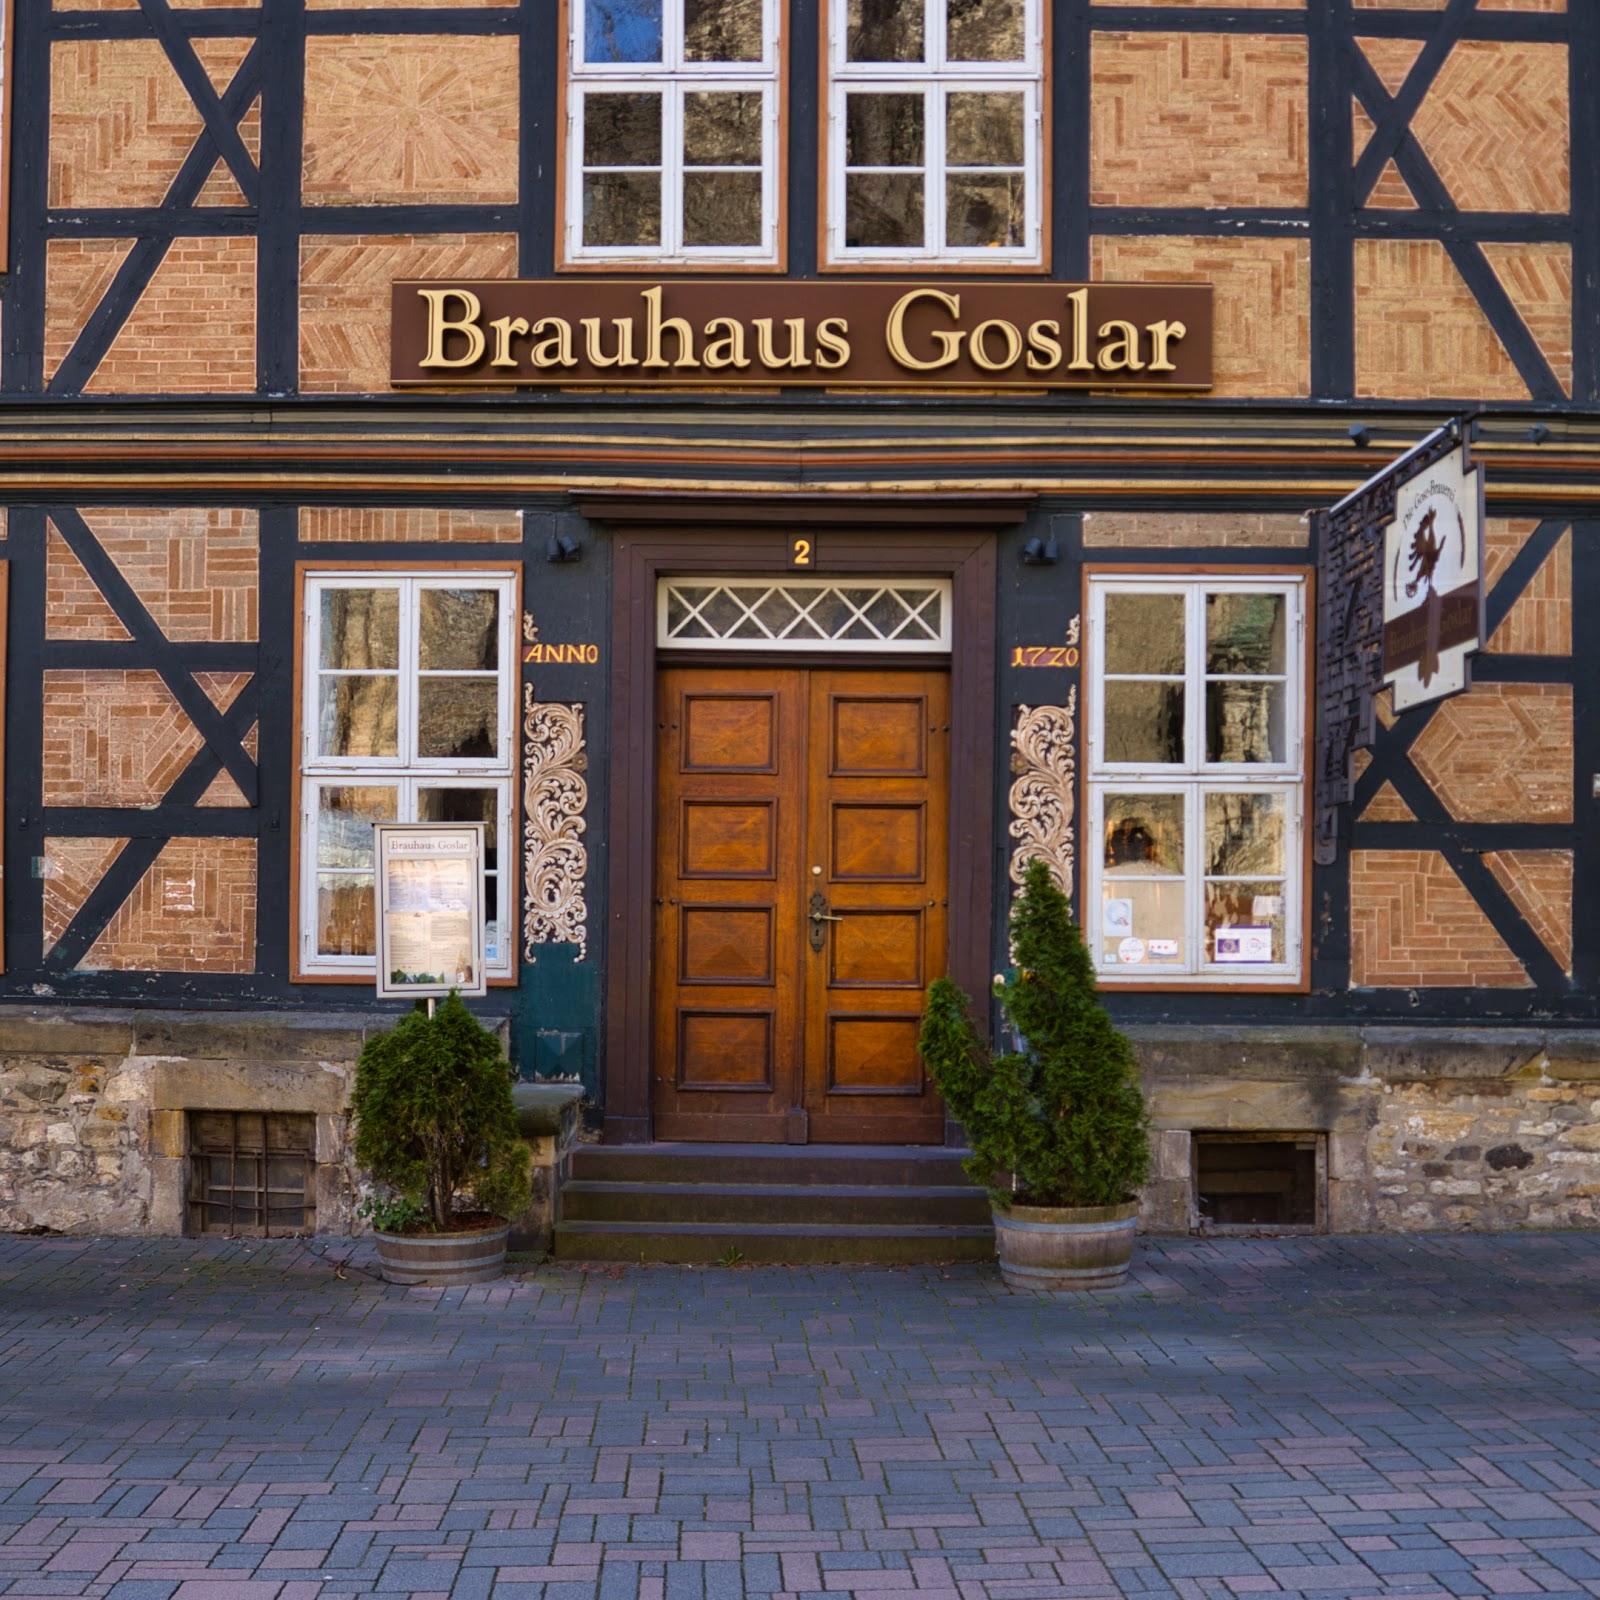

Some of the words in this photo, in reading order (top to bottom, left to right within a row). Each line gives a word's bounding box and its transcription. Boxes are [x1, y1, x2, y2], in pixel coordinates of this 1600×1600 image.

[417, 285, 851, 369] Brauhaus
[885, 287, 1187, 371] Goslar
[794, 539, 810, 565] 2
[524, 643, 599, 664] ANNO
[1010, 646, 1079, 668] 1720
[391, 839, 435, 850] Brauhaus
[438, 839, 468, 850] Goslar
